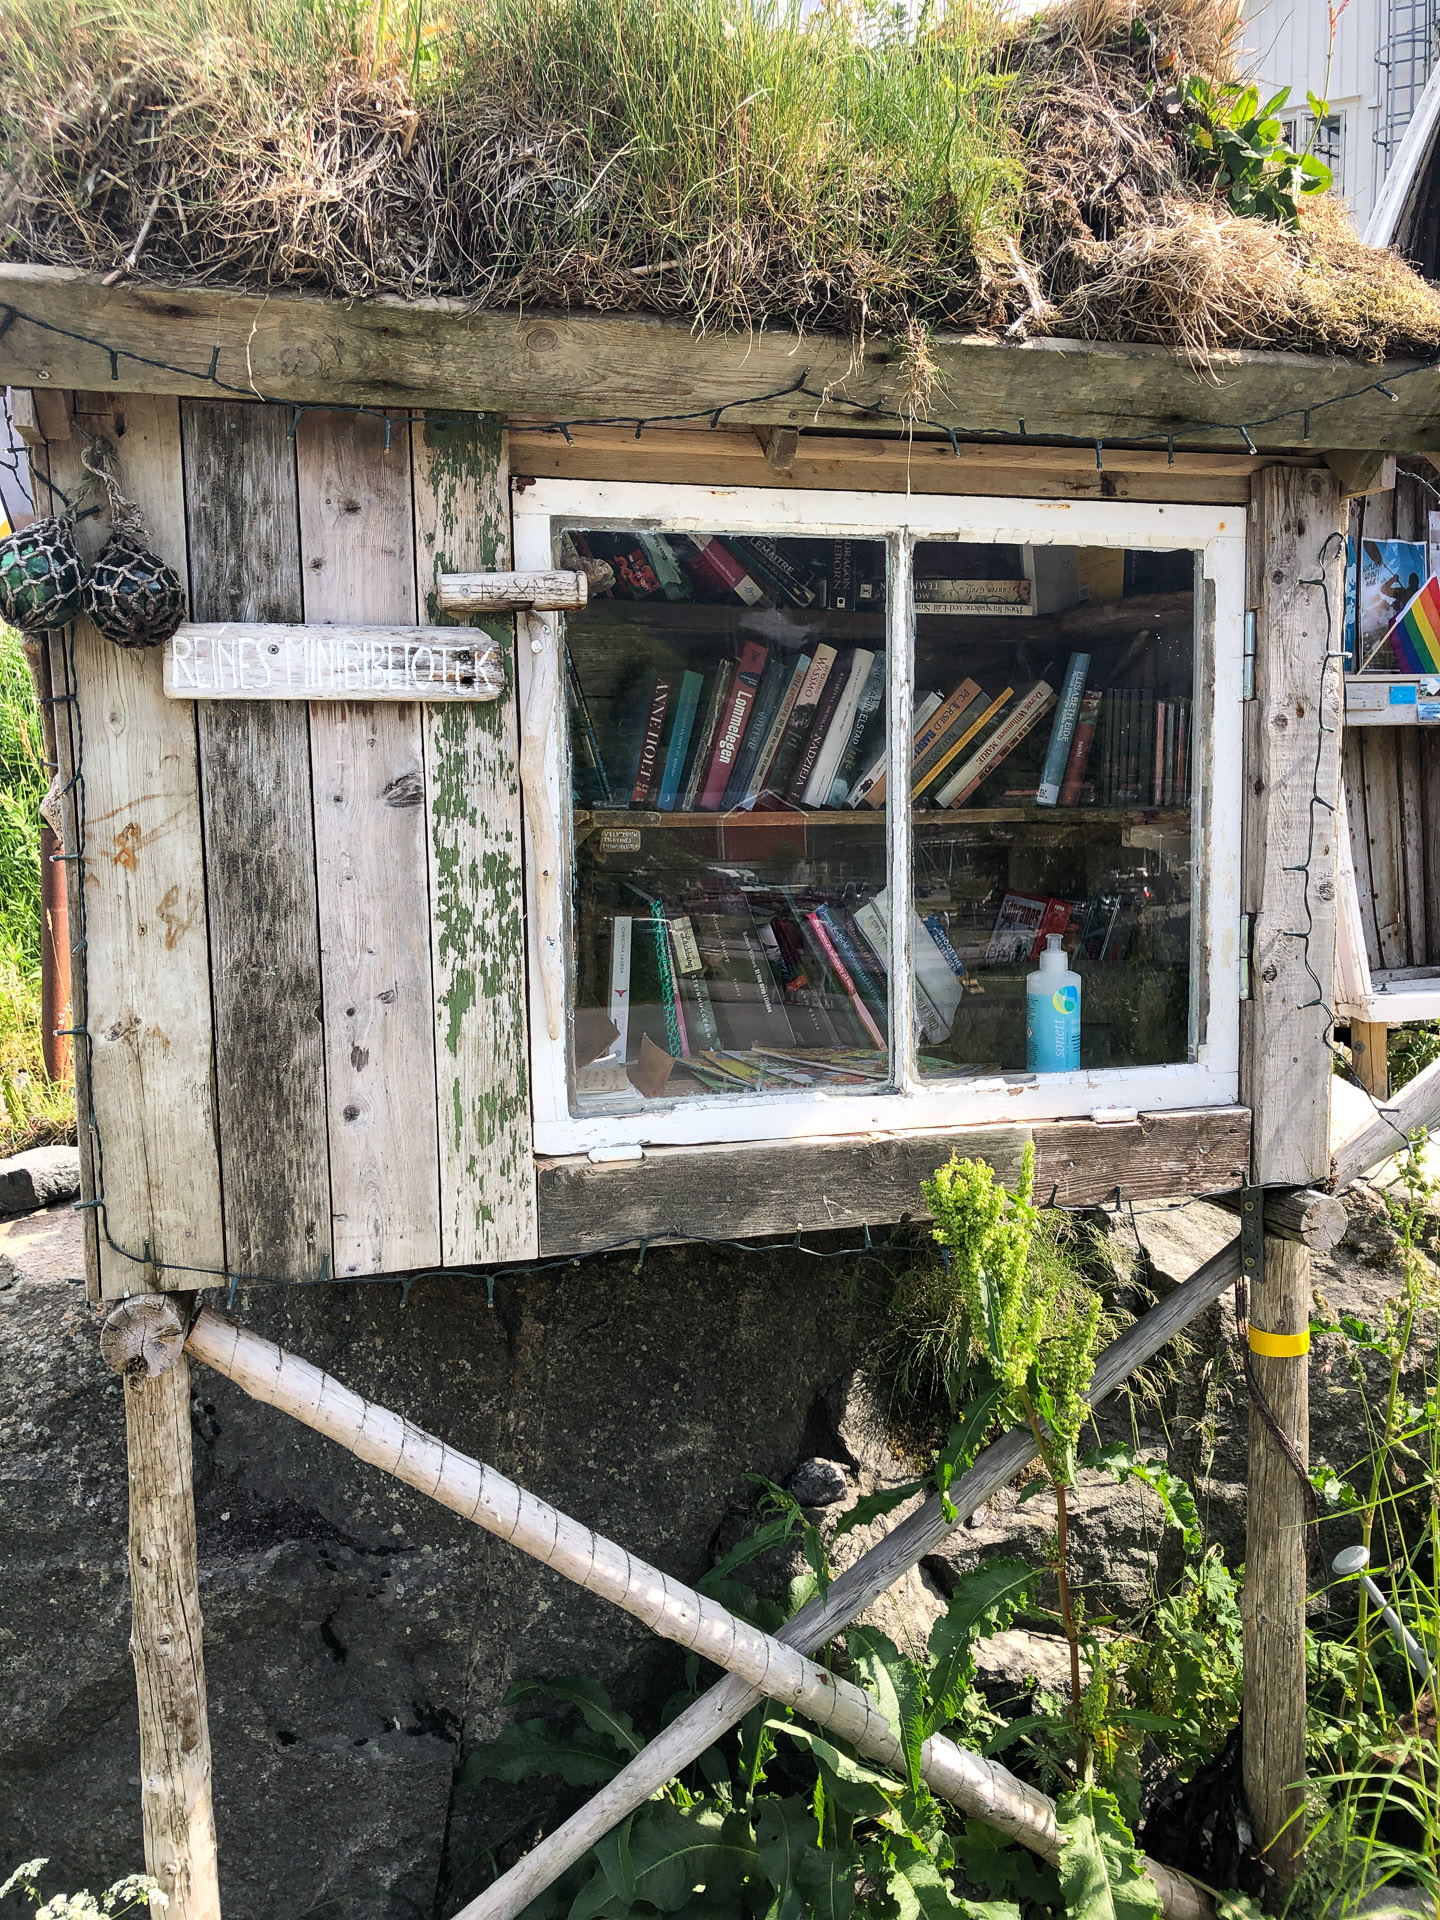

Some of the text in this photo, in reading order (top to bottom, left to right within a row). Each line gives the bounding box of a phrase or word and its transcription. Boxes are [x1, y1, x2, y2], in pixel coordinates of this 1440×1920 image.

[843, 542, 851, 590] DRAGON
[1004, 606, 1022, 614] Poesi
[285, 637, 495, 692] MINIBIBLIOTEK
[805, 657, 828, 697] WASSMO
[872, 659, 886, 683] ANNE
[649, 678, 669, 729] ANNE
[863, 685, 878, 712] KARIN
[1023, 689, 1043, 711] Dorrit
[1066, 670, 1084, 720] ELISABETH
[718, 690, 753, 764] Lommelegen
[853, 714, 868, 744] ELSTAD
[996, 707, 1027, 743] Willumsen
[1061, 721, 1072, 742] EIDE
[640, 731, 659, 780] HOLT
[796, 734, 822, 785] NADZIEJA
[975, 739, 998, 766] MARIE
[999, 899, 1042, 927] Sopranos
[934, 934, 957, 972] MESSENGER
[935, 929, 963, 969] SHOOT THE
[688, 974, 713, 1038] STEINHUGGEREN
[1055, 1019, 1066, 1057] sonett
